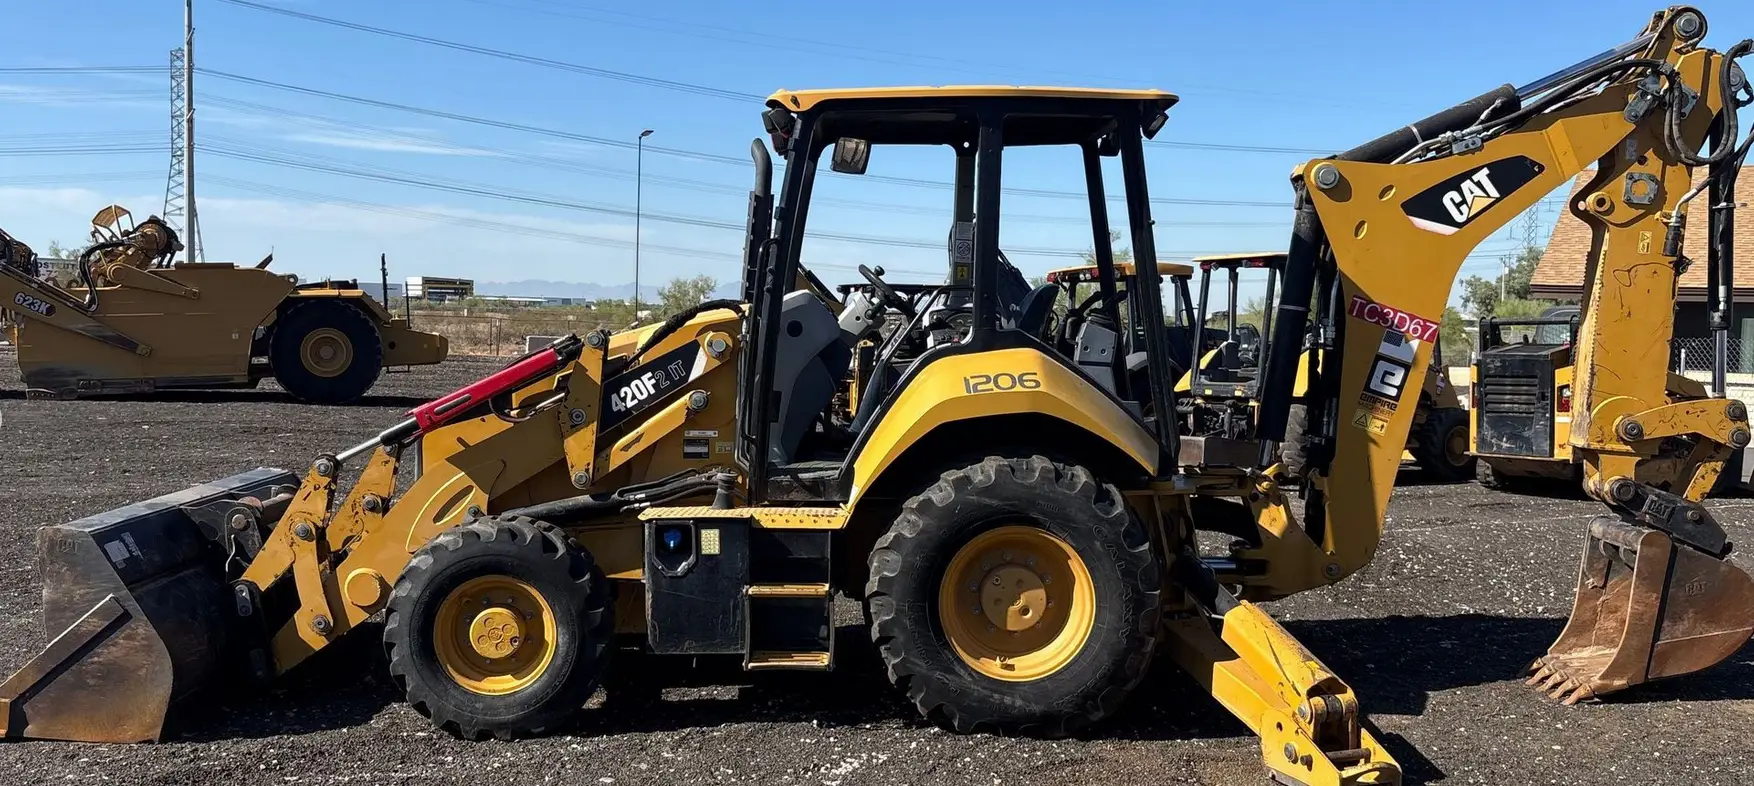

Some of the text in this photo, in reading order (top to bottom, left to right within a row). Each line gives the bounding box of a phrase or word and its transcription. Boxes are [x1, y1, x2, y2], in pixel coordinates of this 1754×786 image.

[1442, 166, 1501, 223] CAT
[14, 291, 51, 315] 623K
[1352, 297, 1438, 341] TC3D67
[668, 359, 686, 380] IT
[963, 372, 1041, 394] 1206
